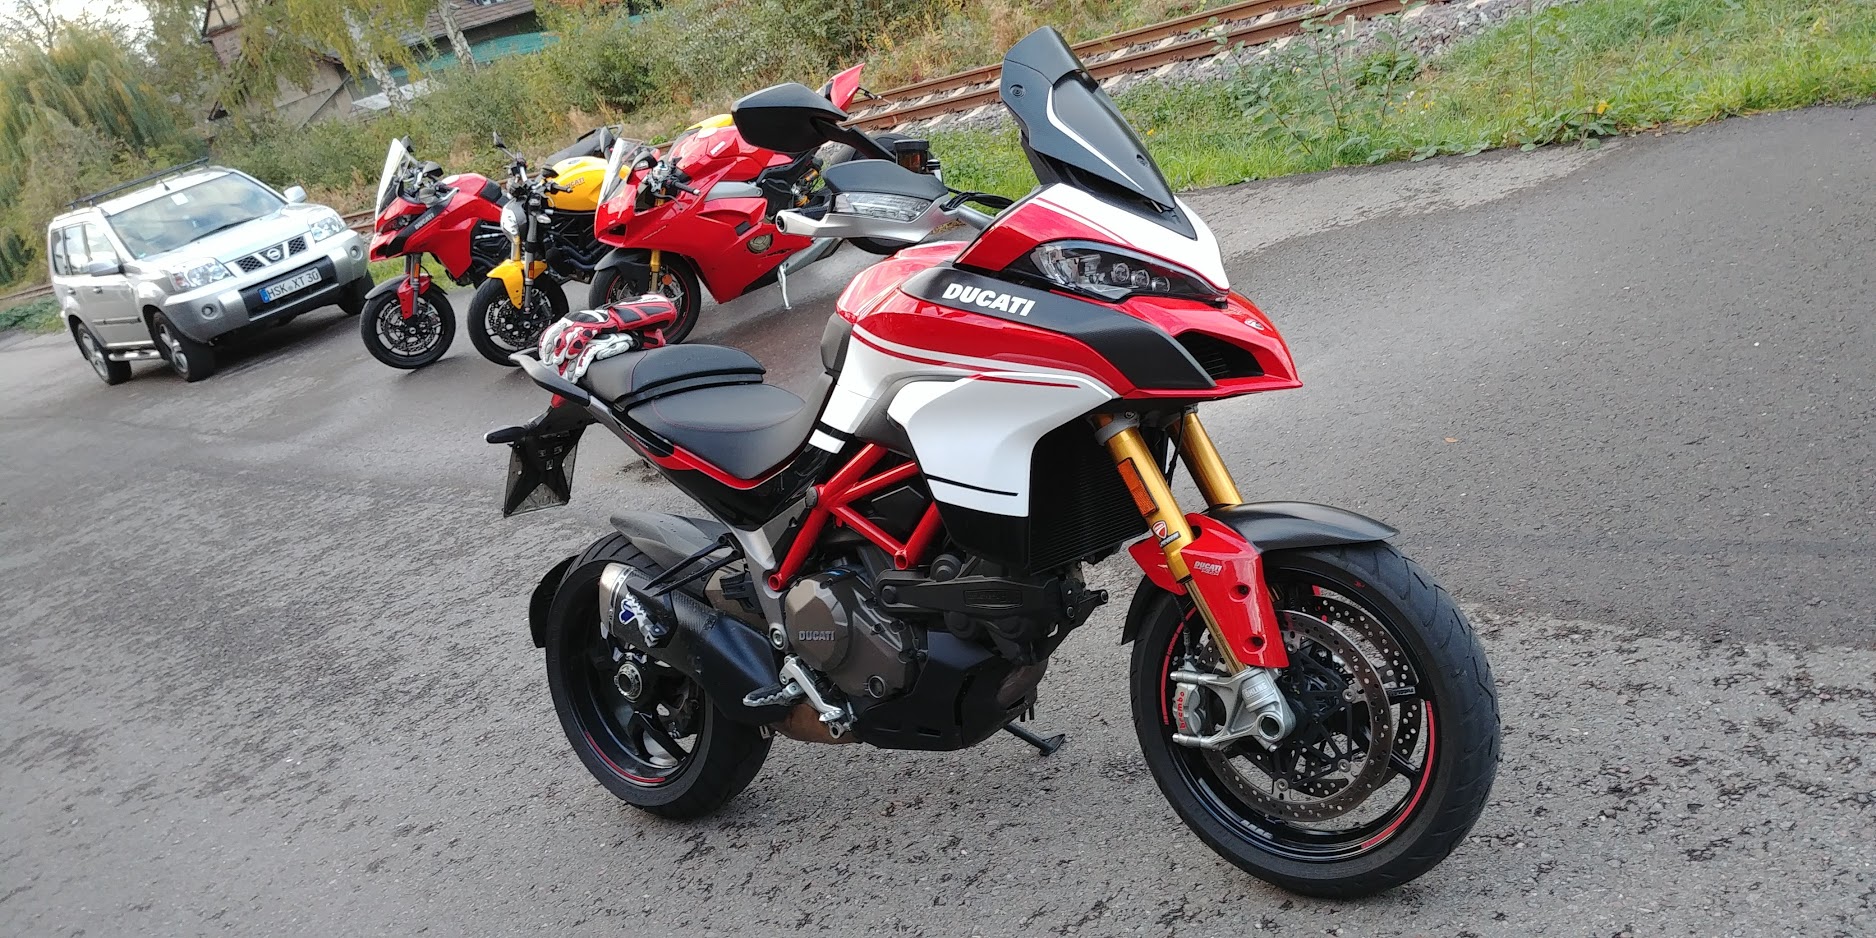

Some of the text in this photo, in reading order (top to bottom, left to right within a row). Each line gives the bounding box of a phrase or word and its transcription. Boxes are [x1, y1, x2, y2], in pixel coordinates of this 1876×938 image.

[414, 212, 435, 230] DUCATI
[266, 271, 319, 299] HSK XT 30
[942, 283, 1036, 317] DUCATI
[1194, 561, 1222, 572] DUCATI
[799, 630, 835, 641] DUCATI
[1177, 691, 1186, 729] brembo
